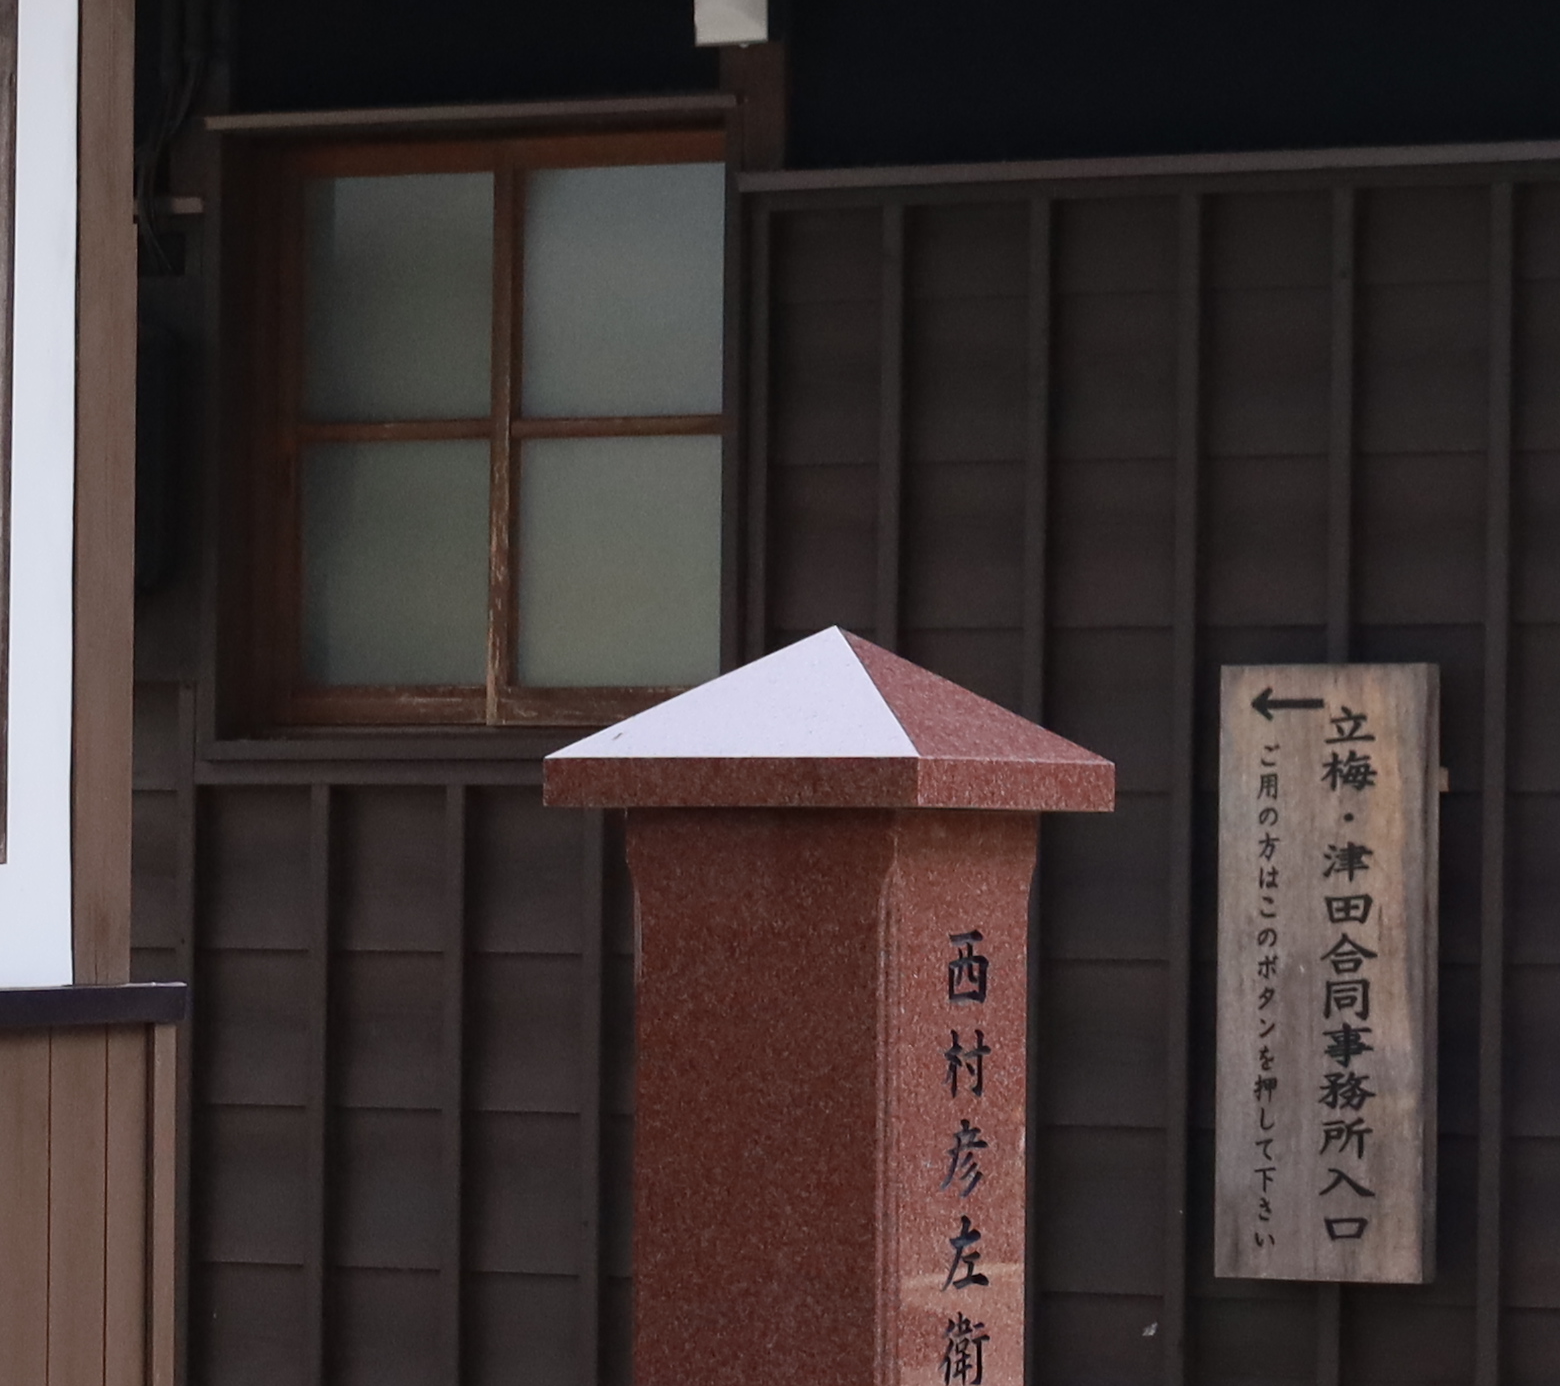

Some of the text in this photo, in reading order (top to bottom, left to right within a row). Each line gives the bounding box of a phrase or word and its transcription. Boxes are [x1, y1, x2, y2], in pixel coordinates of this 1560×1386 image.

[1253, 744, 1280, 1249] ご用の方はこのボタンを押して下さい
[1318, 708, 1378, 1242] 立梅・津田合同事務所入口
